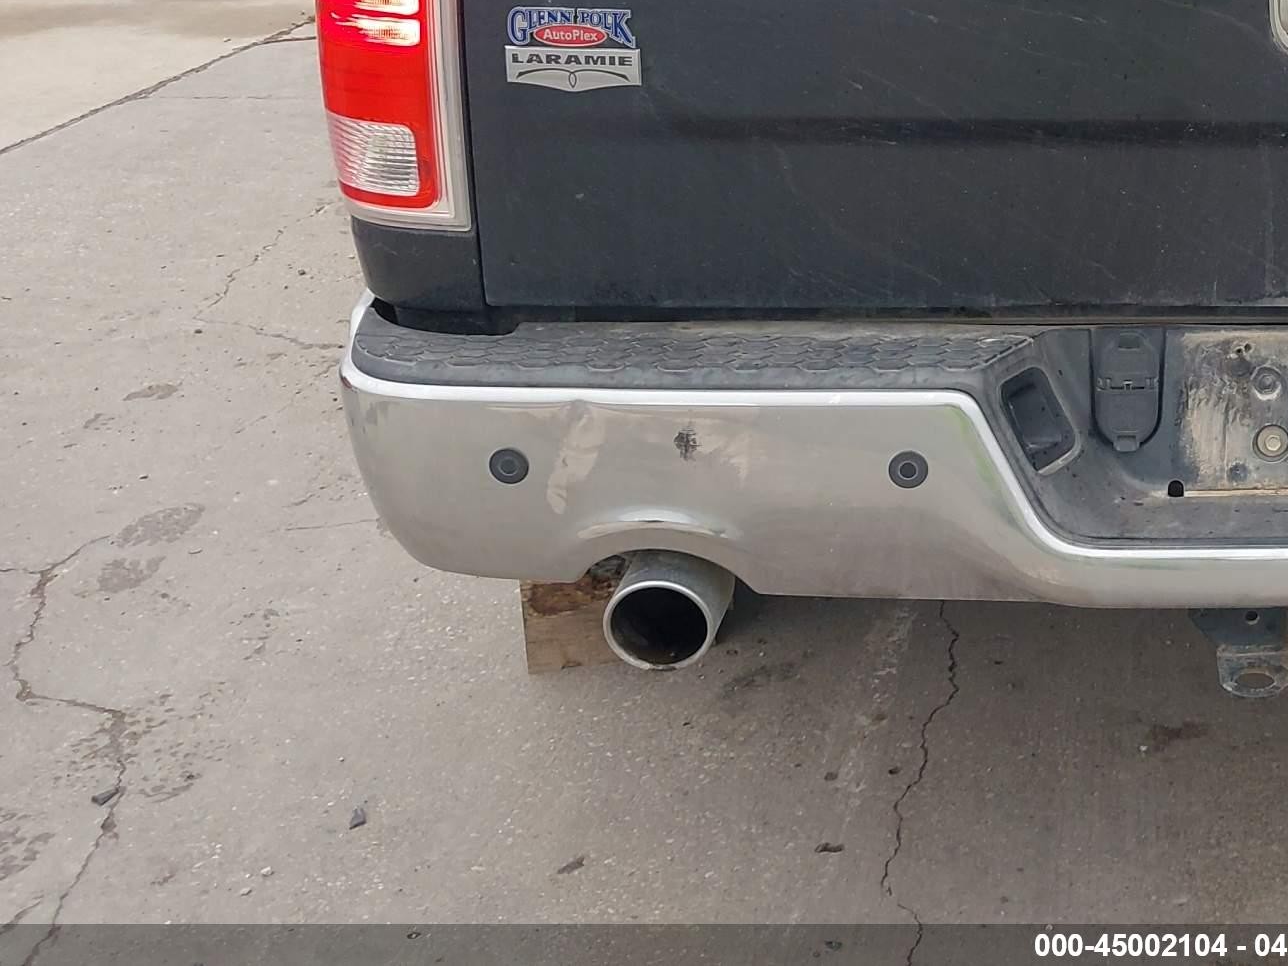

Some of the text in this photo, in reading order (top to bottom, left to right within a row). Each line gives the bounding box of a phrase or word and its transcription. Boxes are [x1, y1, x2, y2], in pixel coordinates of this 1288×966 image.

[509, 7, 634, 45] GLENN POLK
[543, 29, 598, 42] AutoPlex
[511, 52, 633, 67] LARAMIE
